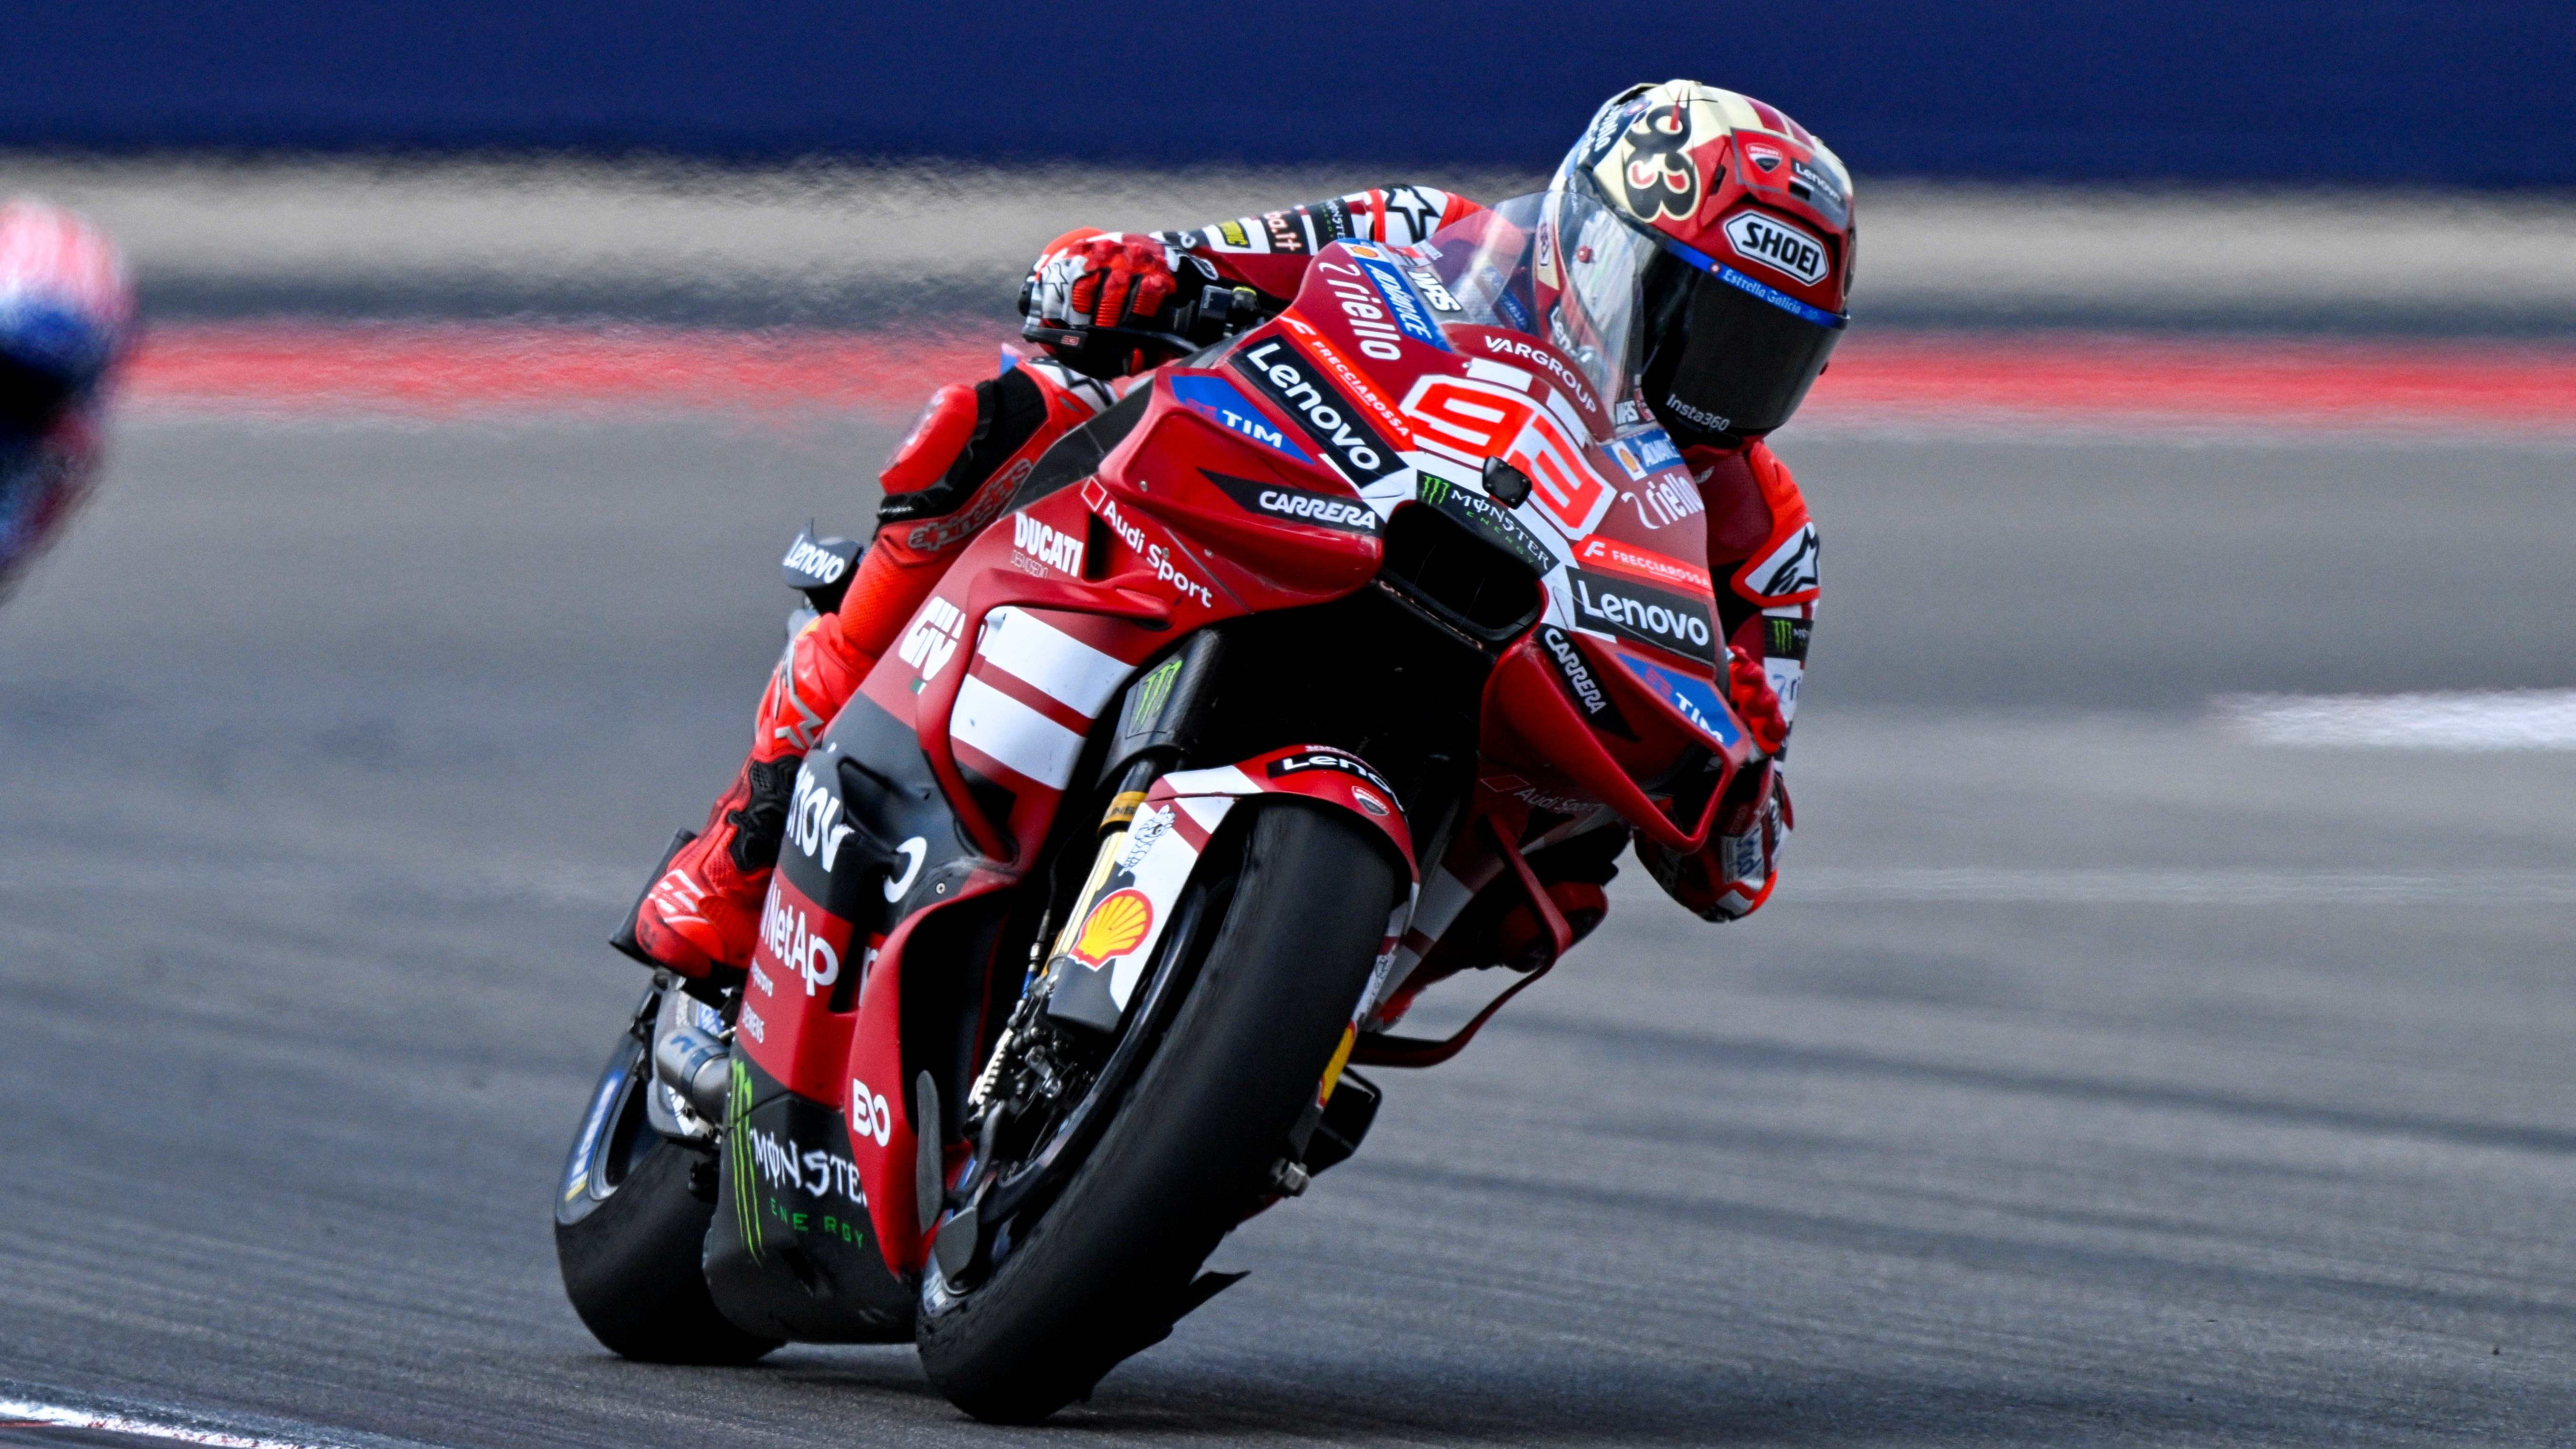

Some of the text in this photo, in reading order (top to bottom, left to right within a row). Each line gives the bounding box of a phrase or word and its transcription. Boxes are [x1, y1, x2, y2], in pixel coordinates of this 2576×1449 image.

[1623, 104, 1701, 223] 93
[1742, 221, 1820, 277] SHOEI
[1326, 278, 1401, 361] riello
[1723, 268, 1766, 298] Estrella
[1767, 290, 1802, 314] Galicia
[1246, 342, 1381, 470] Lenovo
[1311, 341, 1409, 437] FRECCIAROSSA
[1666, 393, 1730, 432] Insta360
[1221, 409, 1283, 449] TIM
[1410, 383, 1604, 529] 93
[1259, 490, 1376, 530] CARRERA
[1451, 489, 1549, 570] MONSTER
[782, 533, 845, 584] Lenovo
[1014, 510, 1084, 577] DUCATI
[1103, 500, 1212, 608] Audi Sport
[1611, 550, 1709, 586] FRECCIAROSSA
[1578, 580, 1709, 646] Lenovo
[1544, 627, 1607, 714] CARRERA
[1283, 756, 1403, 811] Leno
[770, 1197, 864, 1249] ENERGY
